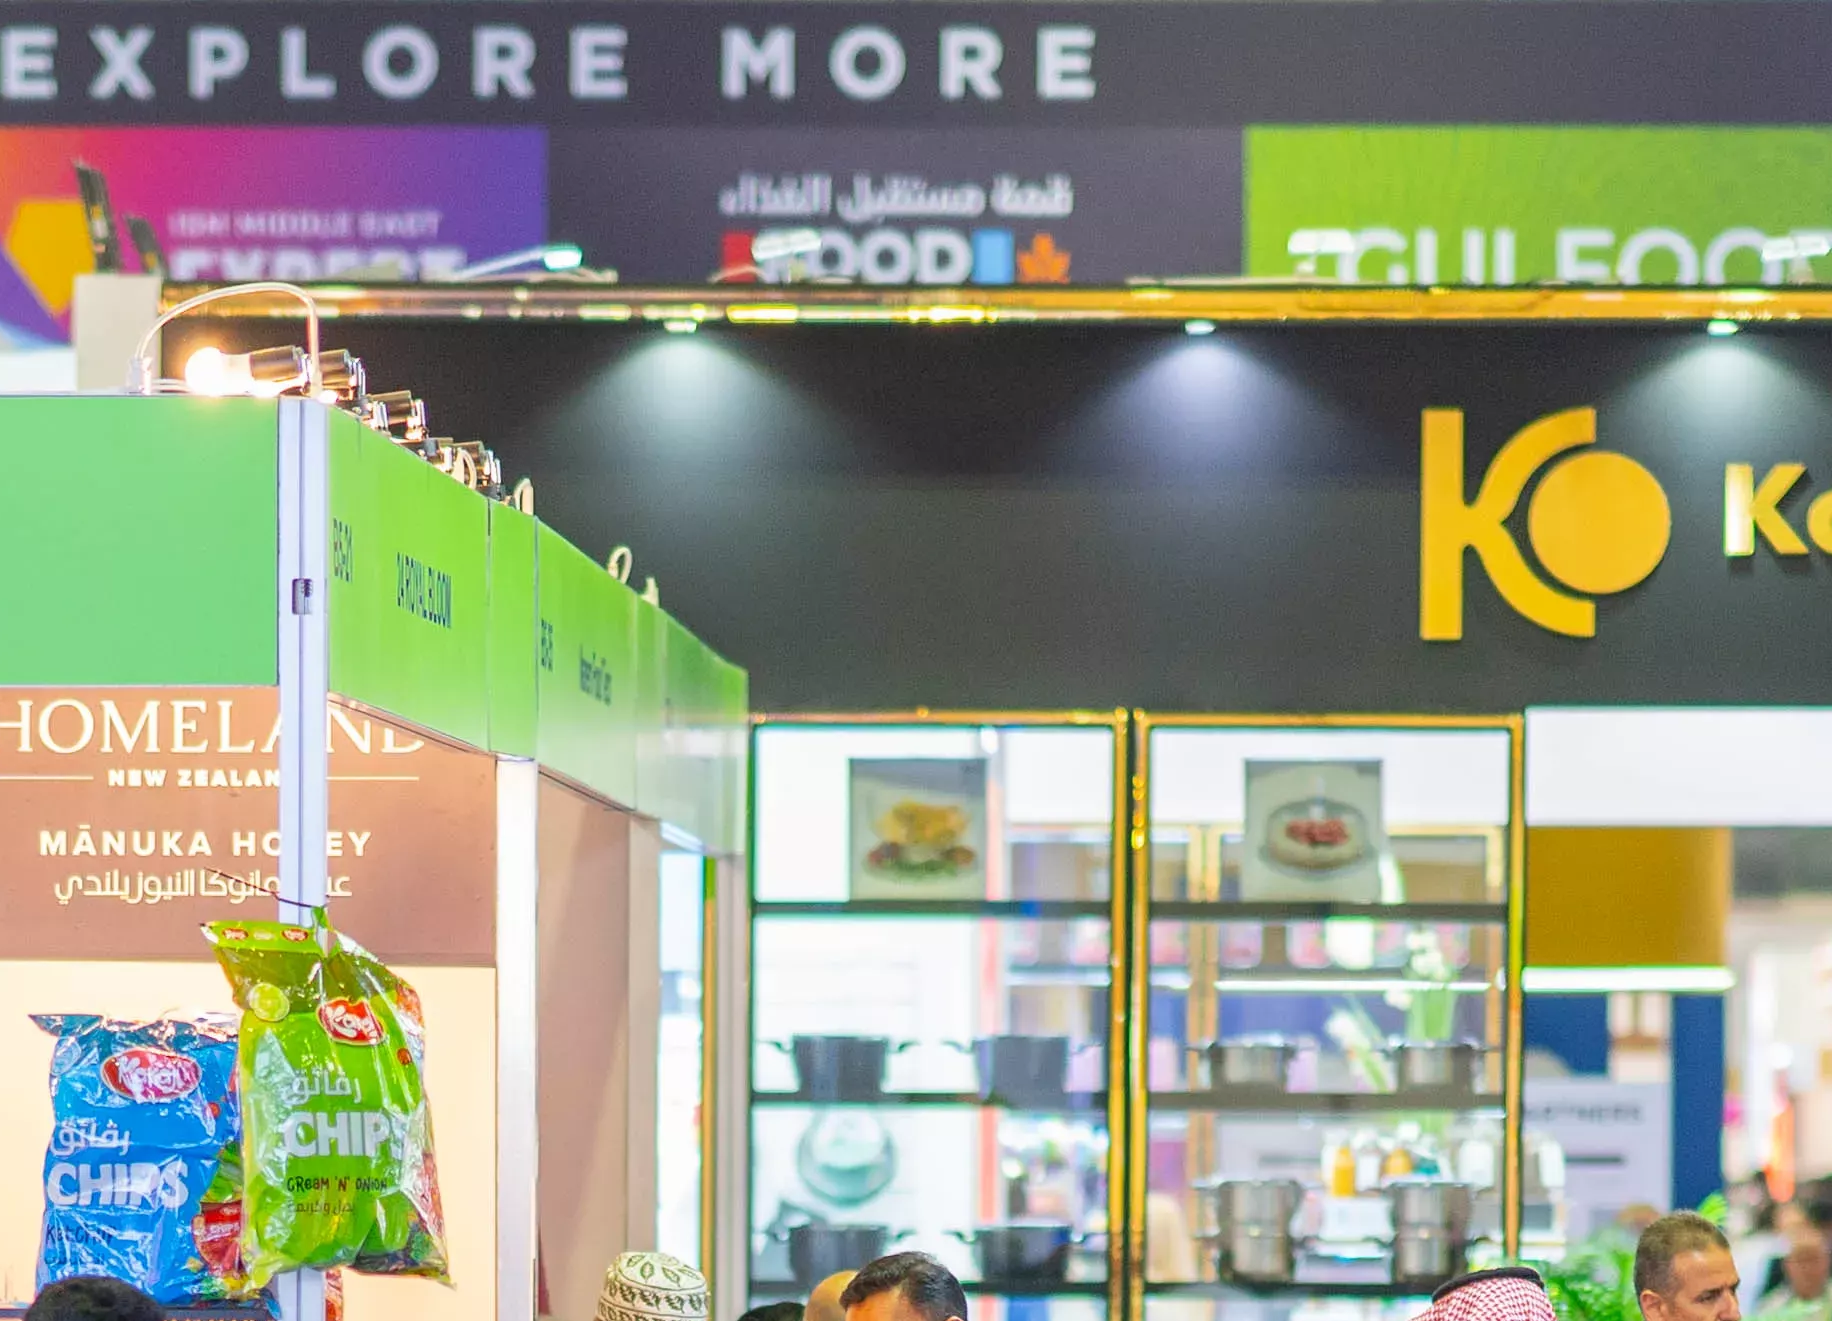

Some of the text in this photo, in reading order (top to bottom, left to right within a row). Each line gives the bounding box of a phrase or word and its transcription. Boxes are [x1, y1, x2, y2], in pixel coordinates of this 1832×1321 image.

[0, 26, 1096, 101] EXPLORE MORE
[108, 769, 281, 787] NEW ZEALAN
[39, 824, 372, 856] MĀNUKA HOEY
[47, 1162, 189, 1210] CHIPS
